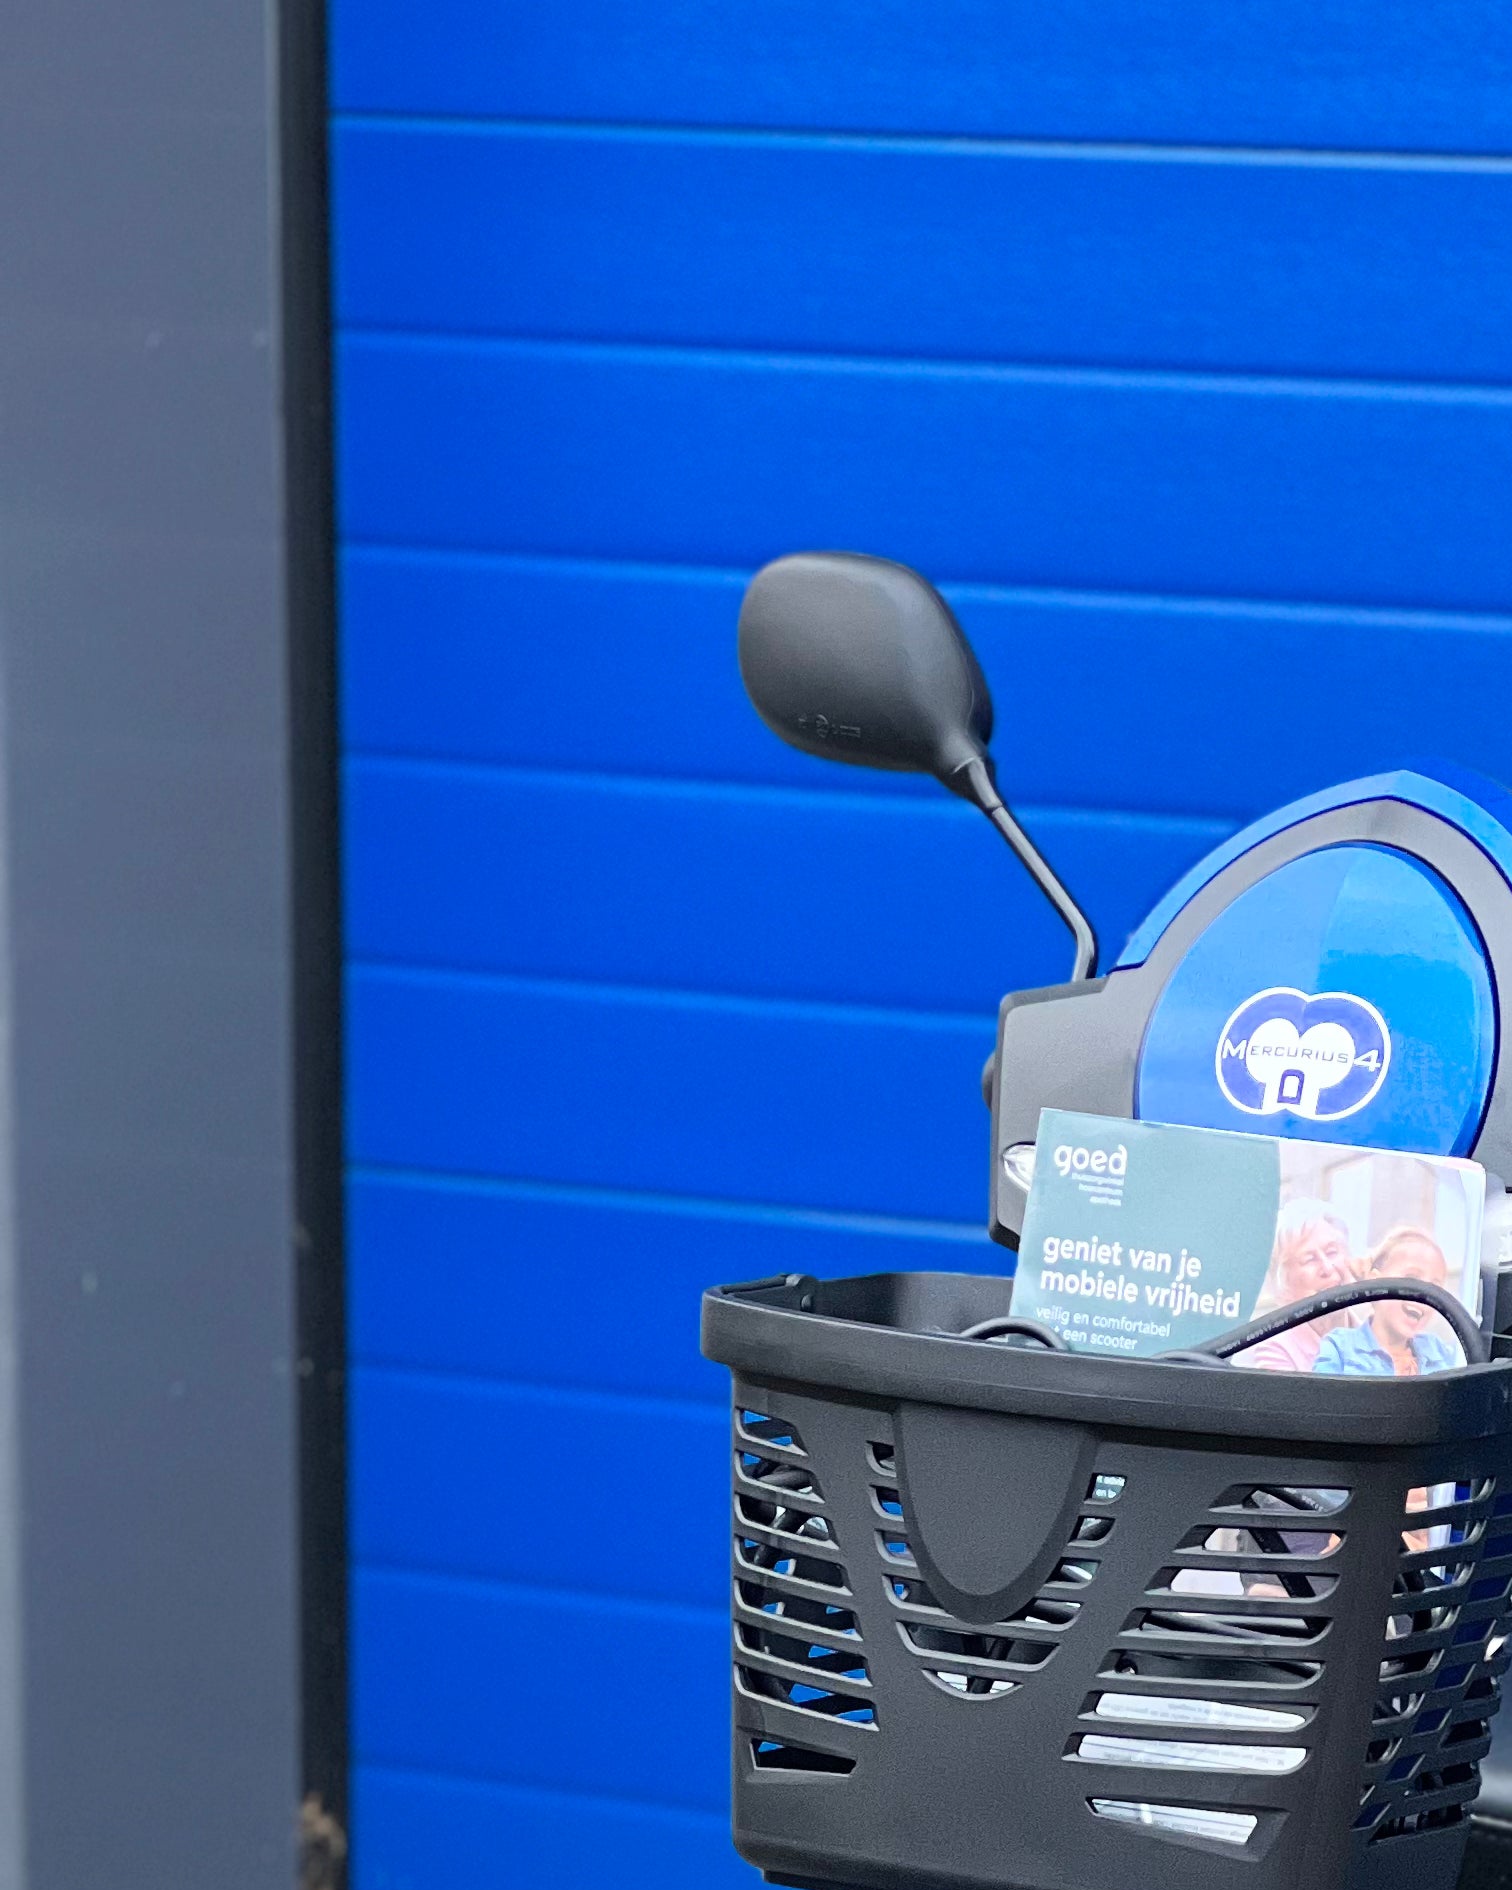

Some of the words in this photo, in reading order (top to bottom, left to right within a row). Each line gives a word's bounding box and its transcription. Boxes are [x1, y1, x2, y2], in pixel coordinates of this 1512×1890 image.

[1053, 1143, 1128, 1177] goed
[1043, 1235, 1124, 1266] geniet
[1128, 1247, 1172, 1274] van
[1175, 1248, 1202, 1282] je
[1039, 1269, 1139, 1304] mobiele
[1144, 1280, 1241, 1318] vrijheid
[1035, 1305, 1071, 1326] veilig
[1073, 1312, 1090, 1325] en
[1092, 1314, 1171, 1338] comfortabel
[1062, 1327, 1087, 1343] een
[1089, 1332, 1139, 1351] scooter
